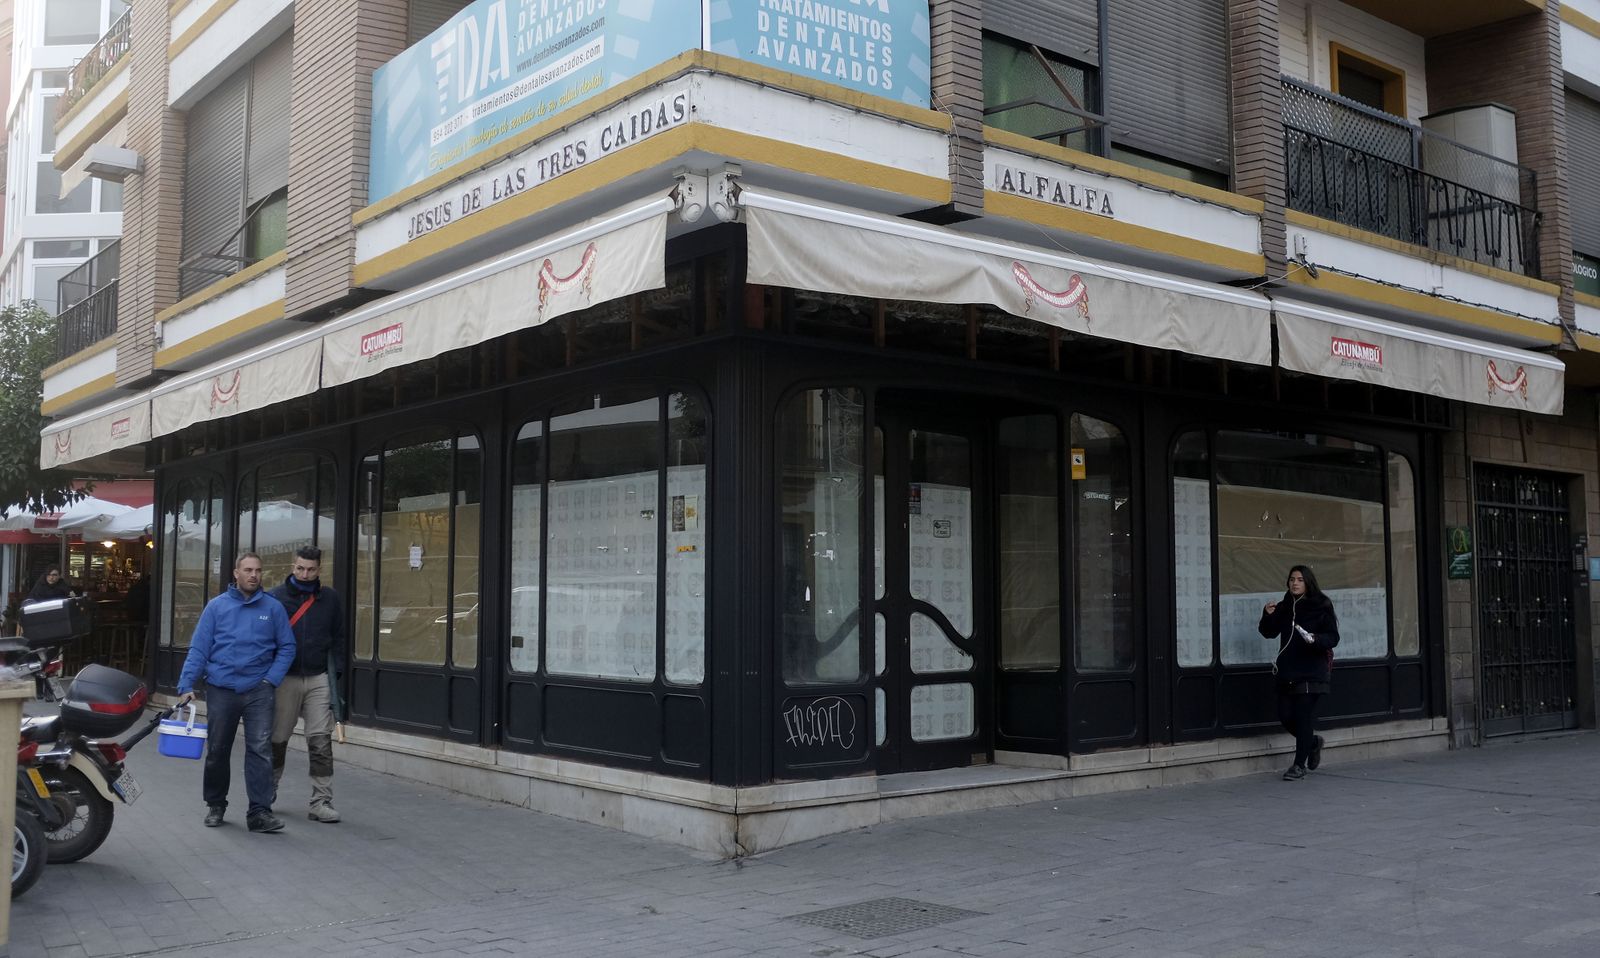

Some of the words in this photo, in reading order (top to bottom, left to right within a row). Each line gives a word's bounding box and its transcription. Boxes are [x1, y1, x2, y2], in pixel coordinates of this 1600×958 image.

[516, 17, 605, 73] www.dentalesavanzados.com
[757, 36, 893, 90] AVANZADOS
[758, 10, 892, 67] DENTALES
[472, 44, 601, 118] tratamientos@dentalesavanzados.com
[408, 201, 451, 238] JESUS
[461, 187, 481, 214] DE
[492, 168, 525, 200] LAS
[538, 140, 587, 181] TRES
[601, 94, 685, 151] CAIDAS
[1001, 168, 1114, 215] ALFALFA
